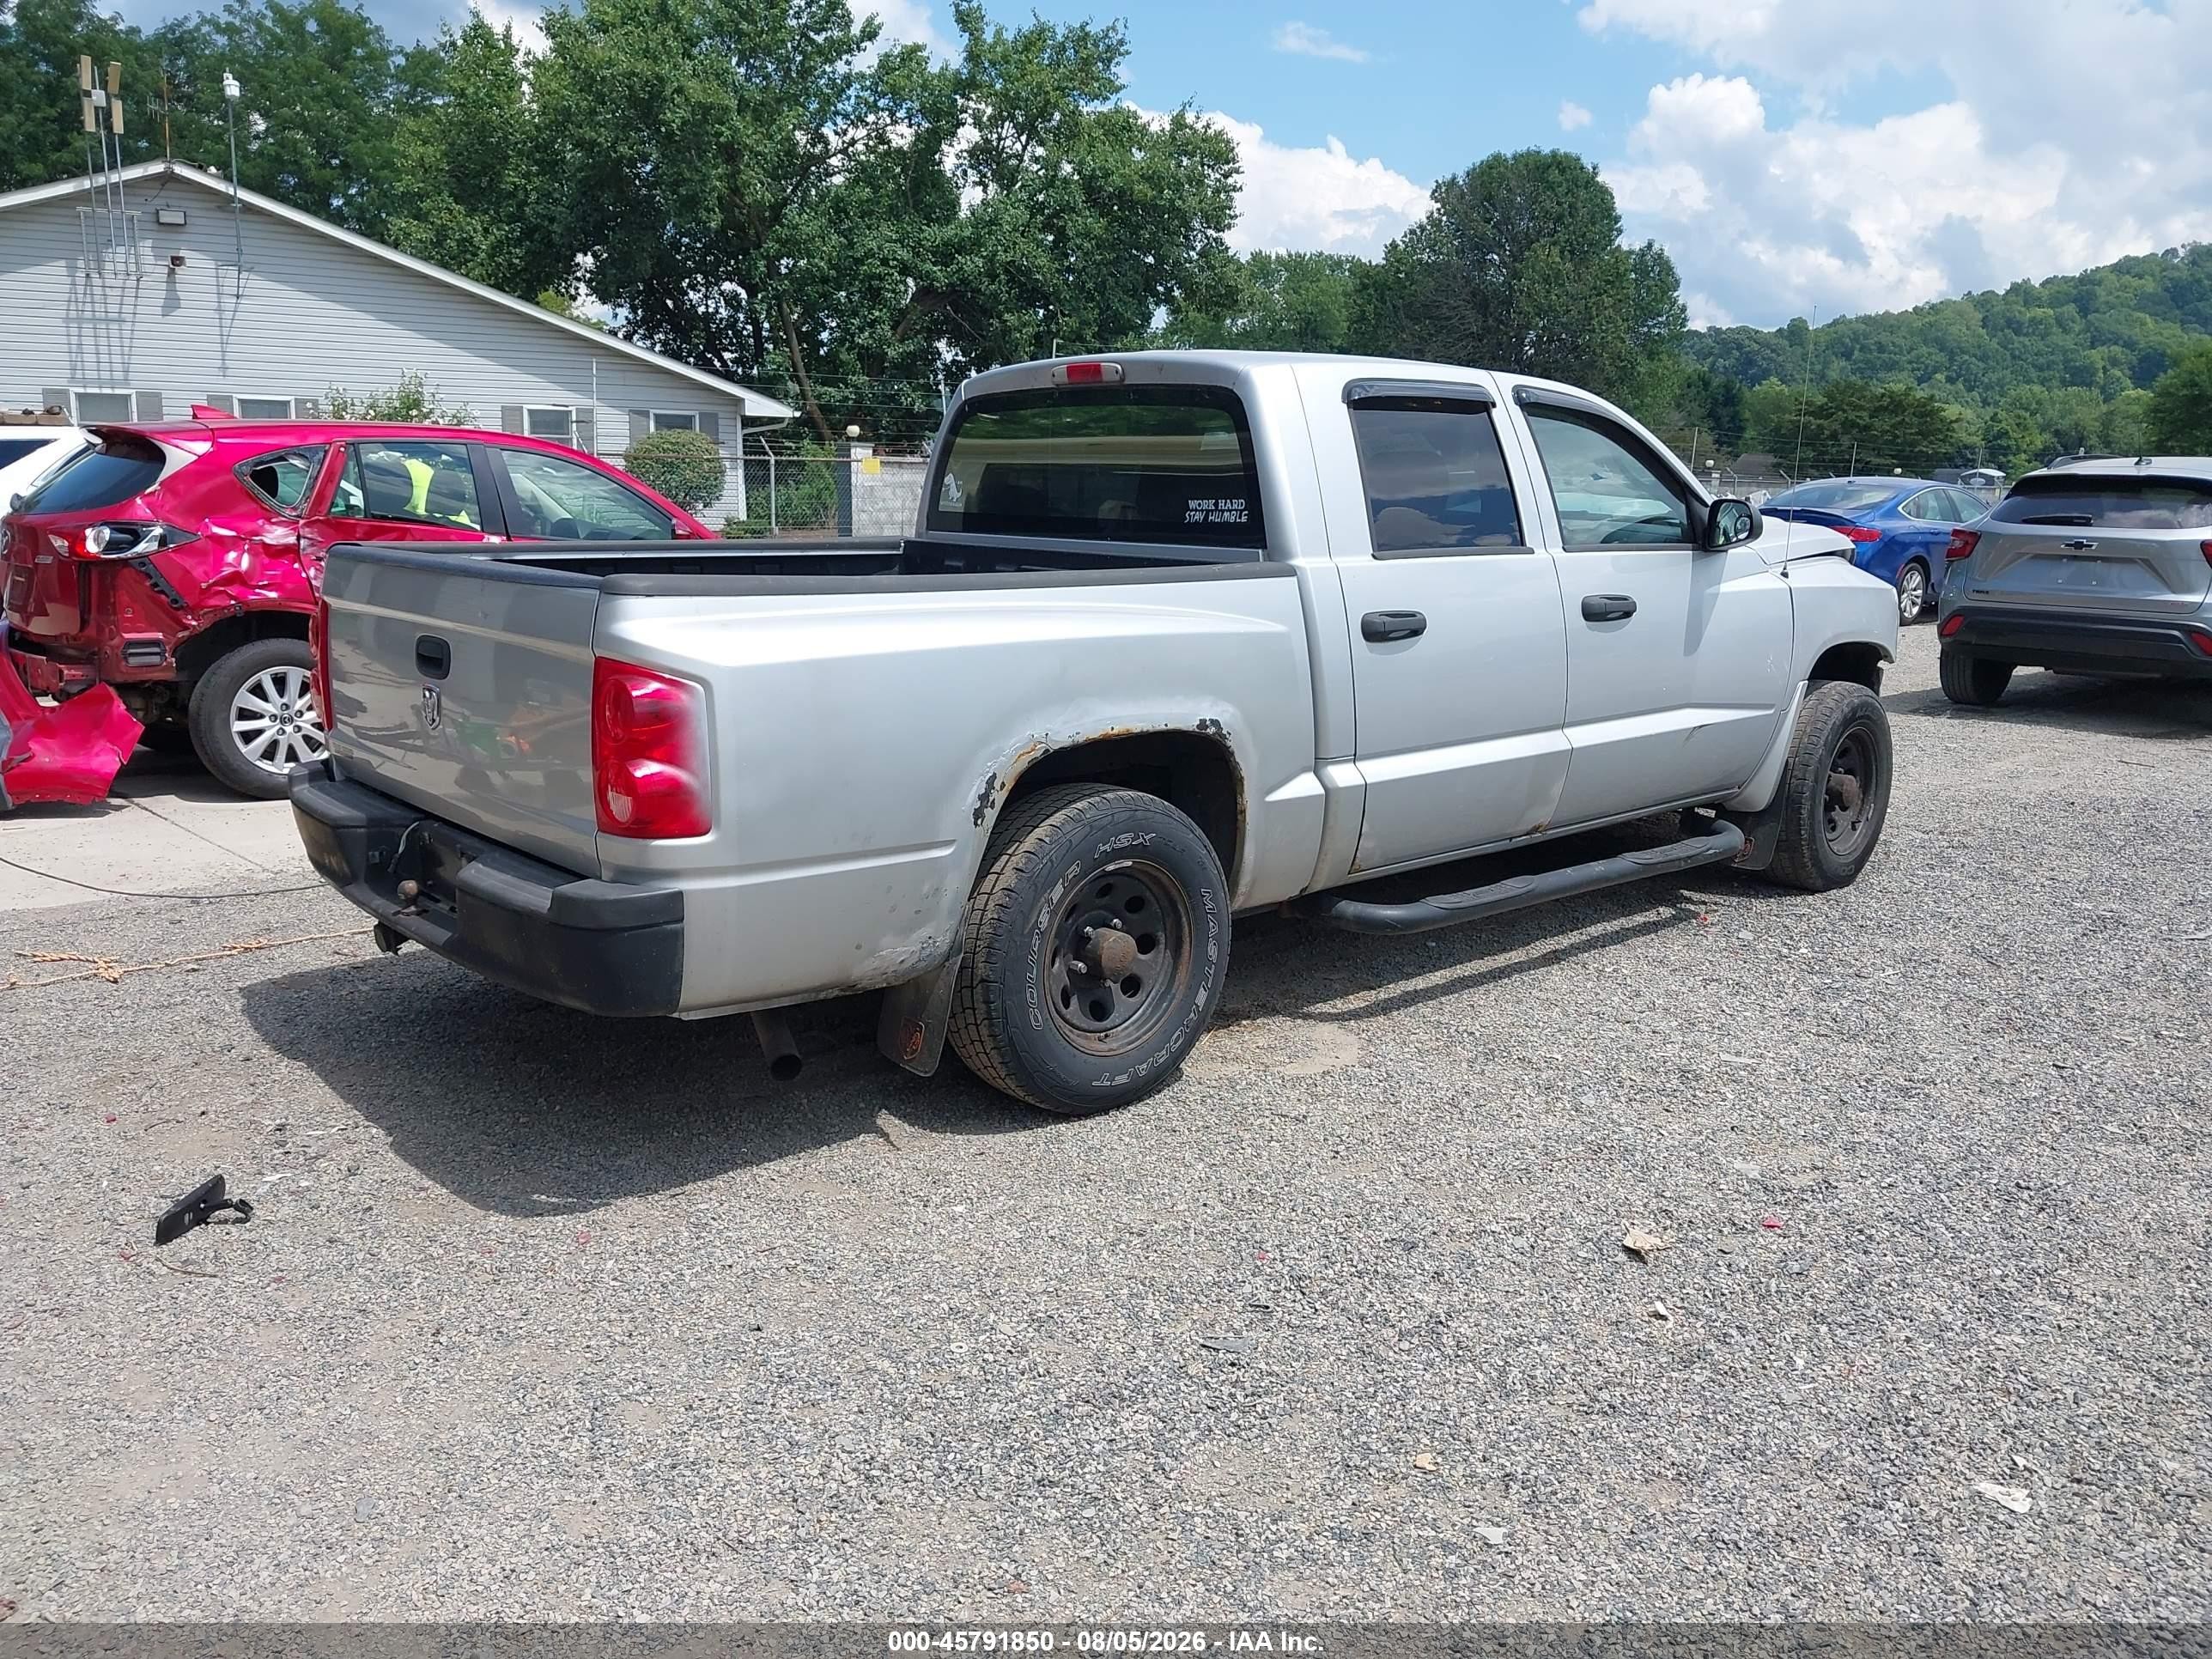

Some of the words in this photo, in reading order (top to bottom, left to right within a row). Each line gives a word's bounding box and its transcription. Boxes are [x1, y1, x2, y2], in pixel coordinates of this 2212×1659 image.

[1188, 500, 1216, 510] WORK
[1218, 499, 1246, 510] HARD
[1183, 510, 1206, 523] STAY
[1207, 510, 1249, 523] HUMBLE
[1026, 860, 1082, 1030] COURSER
[1093, 832, 1157, 859] HSX
